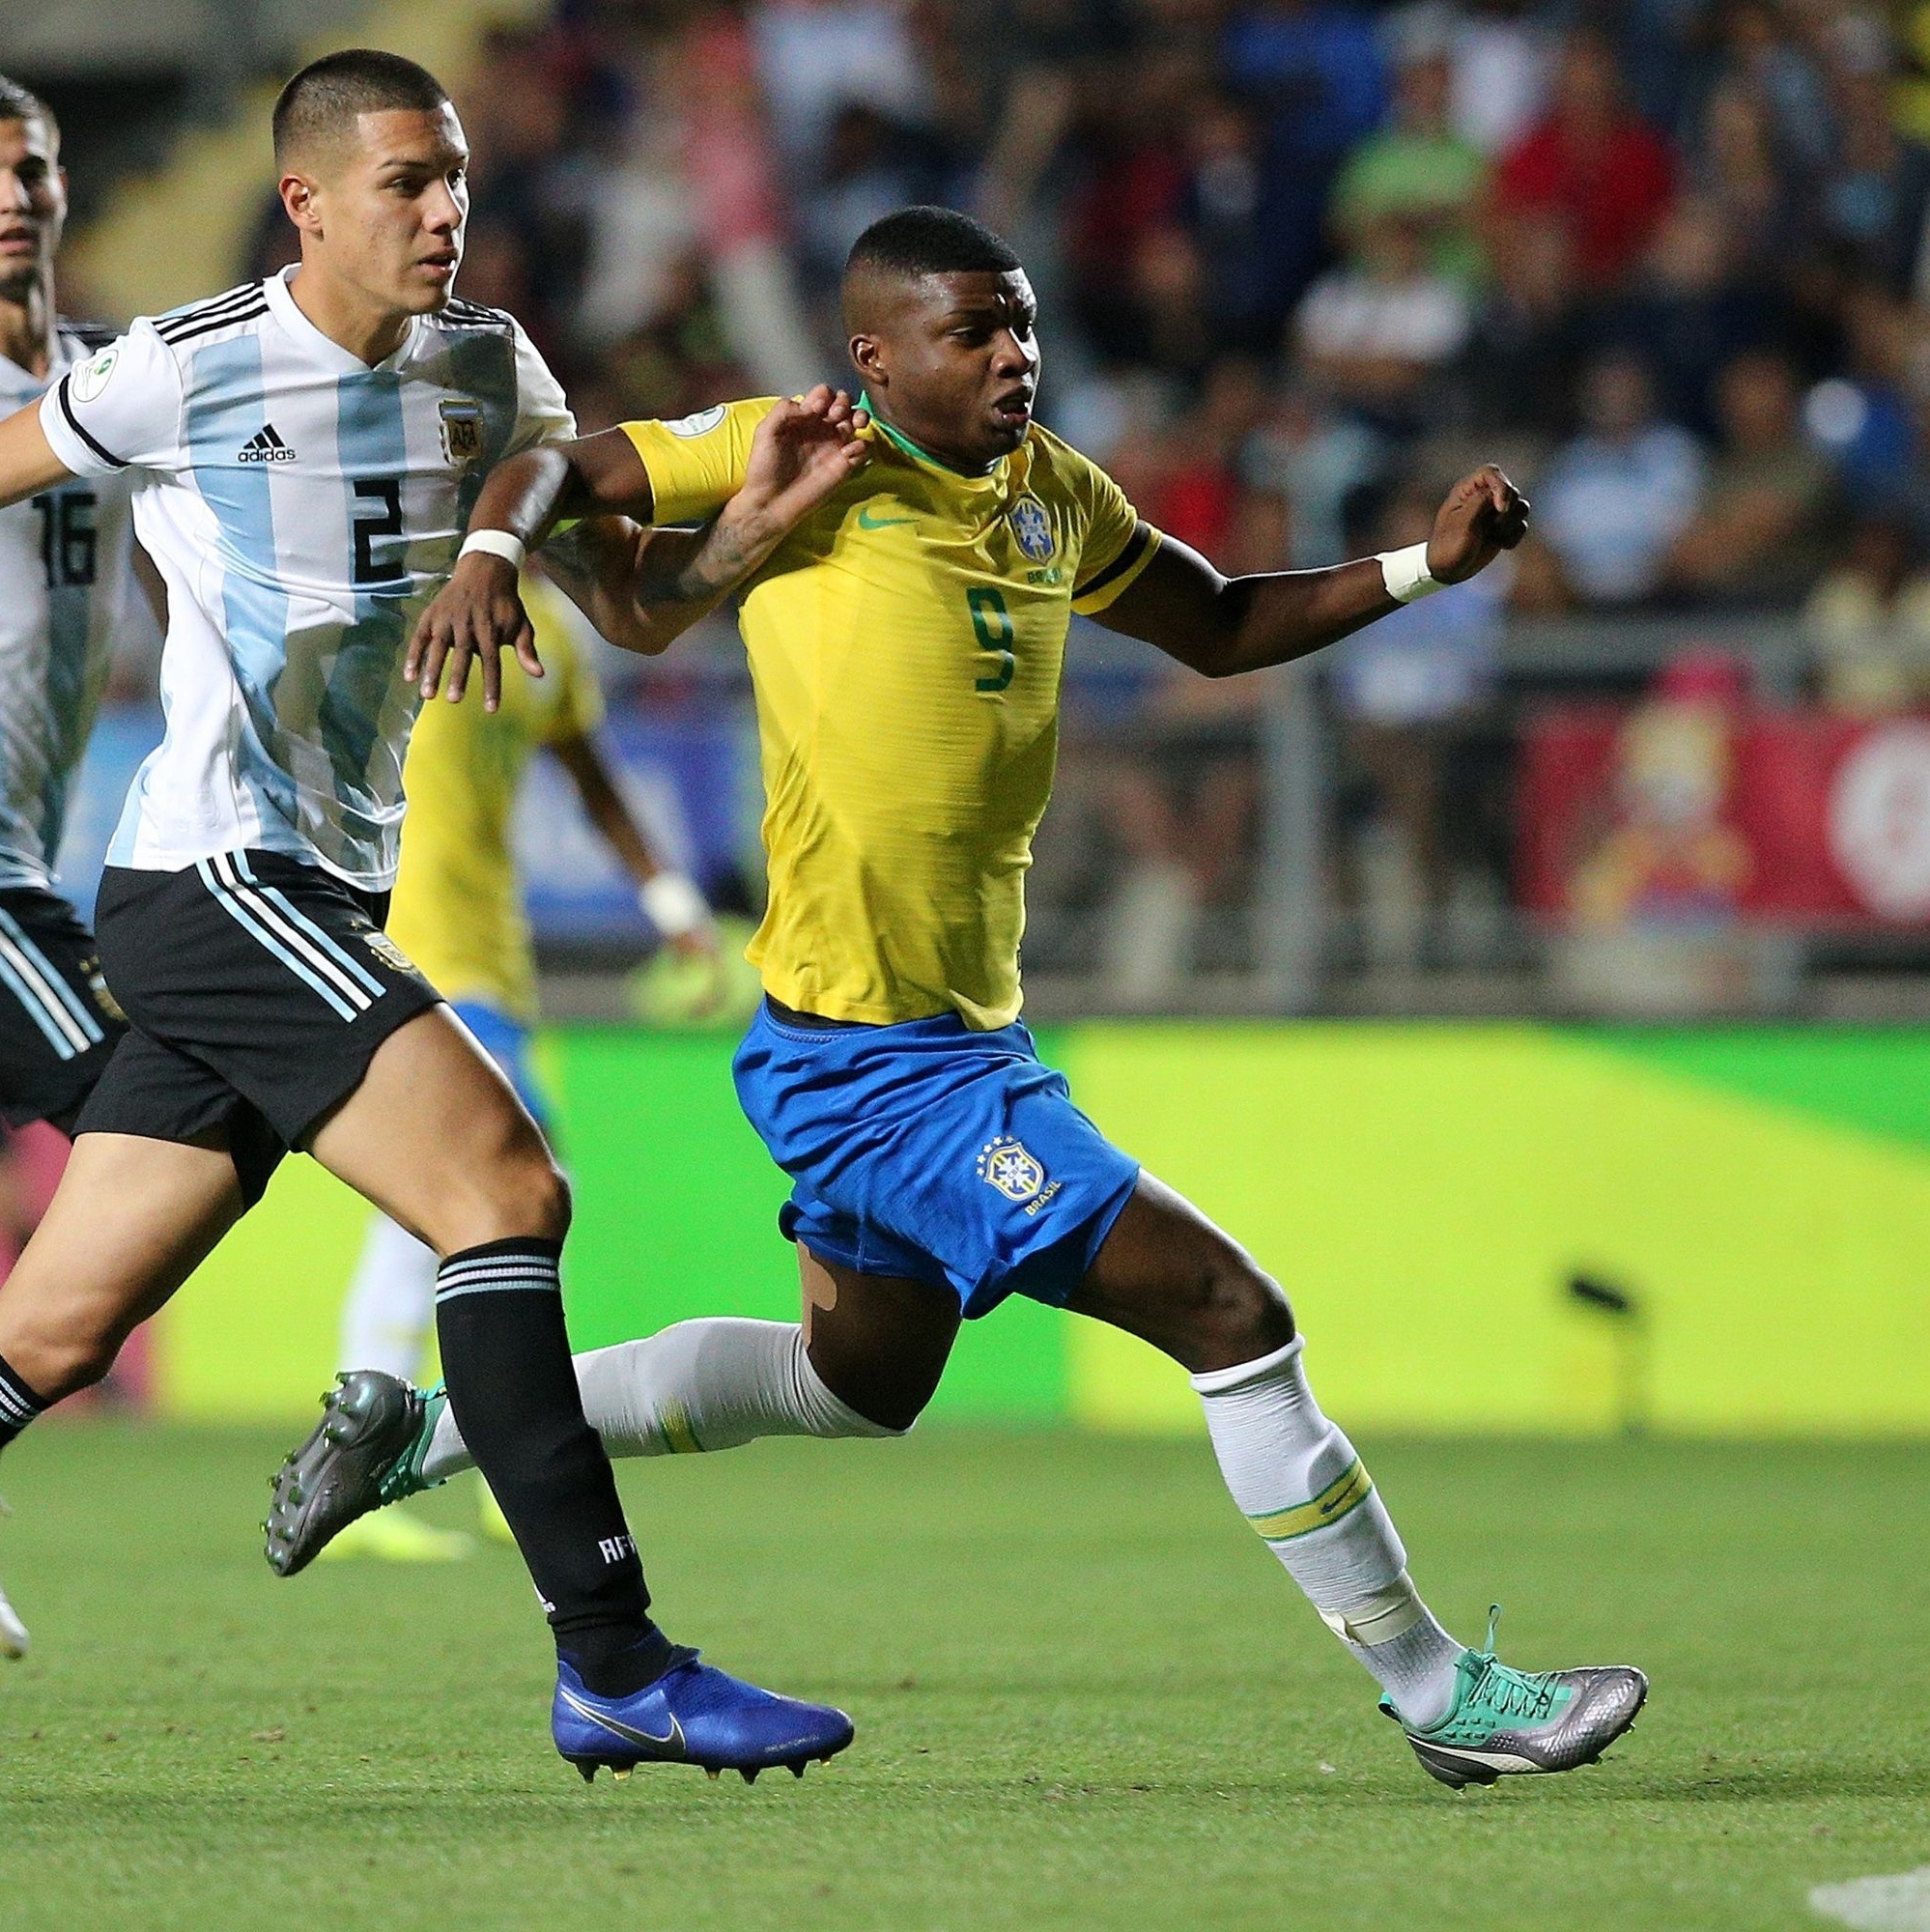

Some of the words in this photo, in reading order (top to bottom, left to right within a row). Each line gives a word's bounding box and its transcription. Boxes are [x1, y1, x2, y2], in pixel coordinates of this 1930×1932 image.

[238, 448, 296, 463] adidas
[32, 492, 97, 587] 16
[354, 479, 405, 583] 2
[967, 587, 1014, 692] 9
[1024, 1180, 1062, 1216] BRASIL
